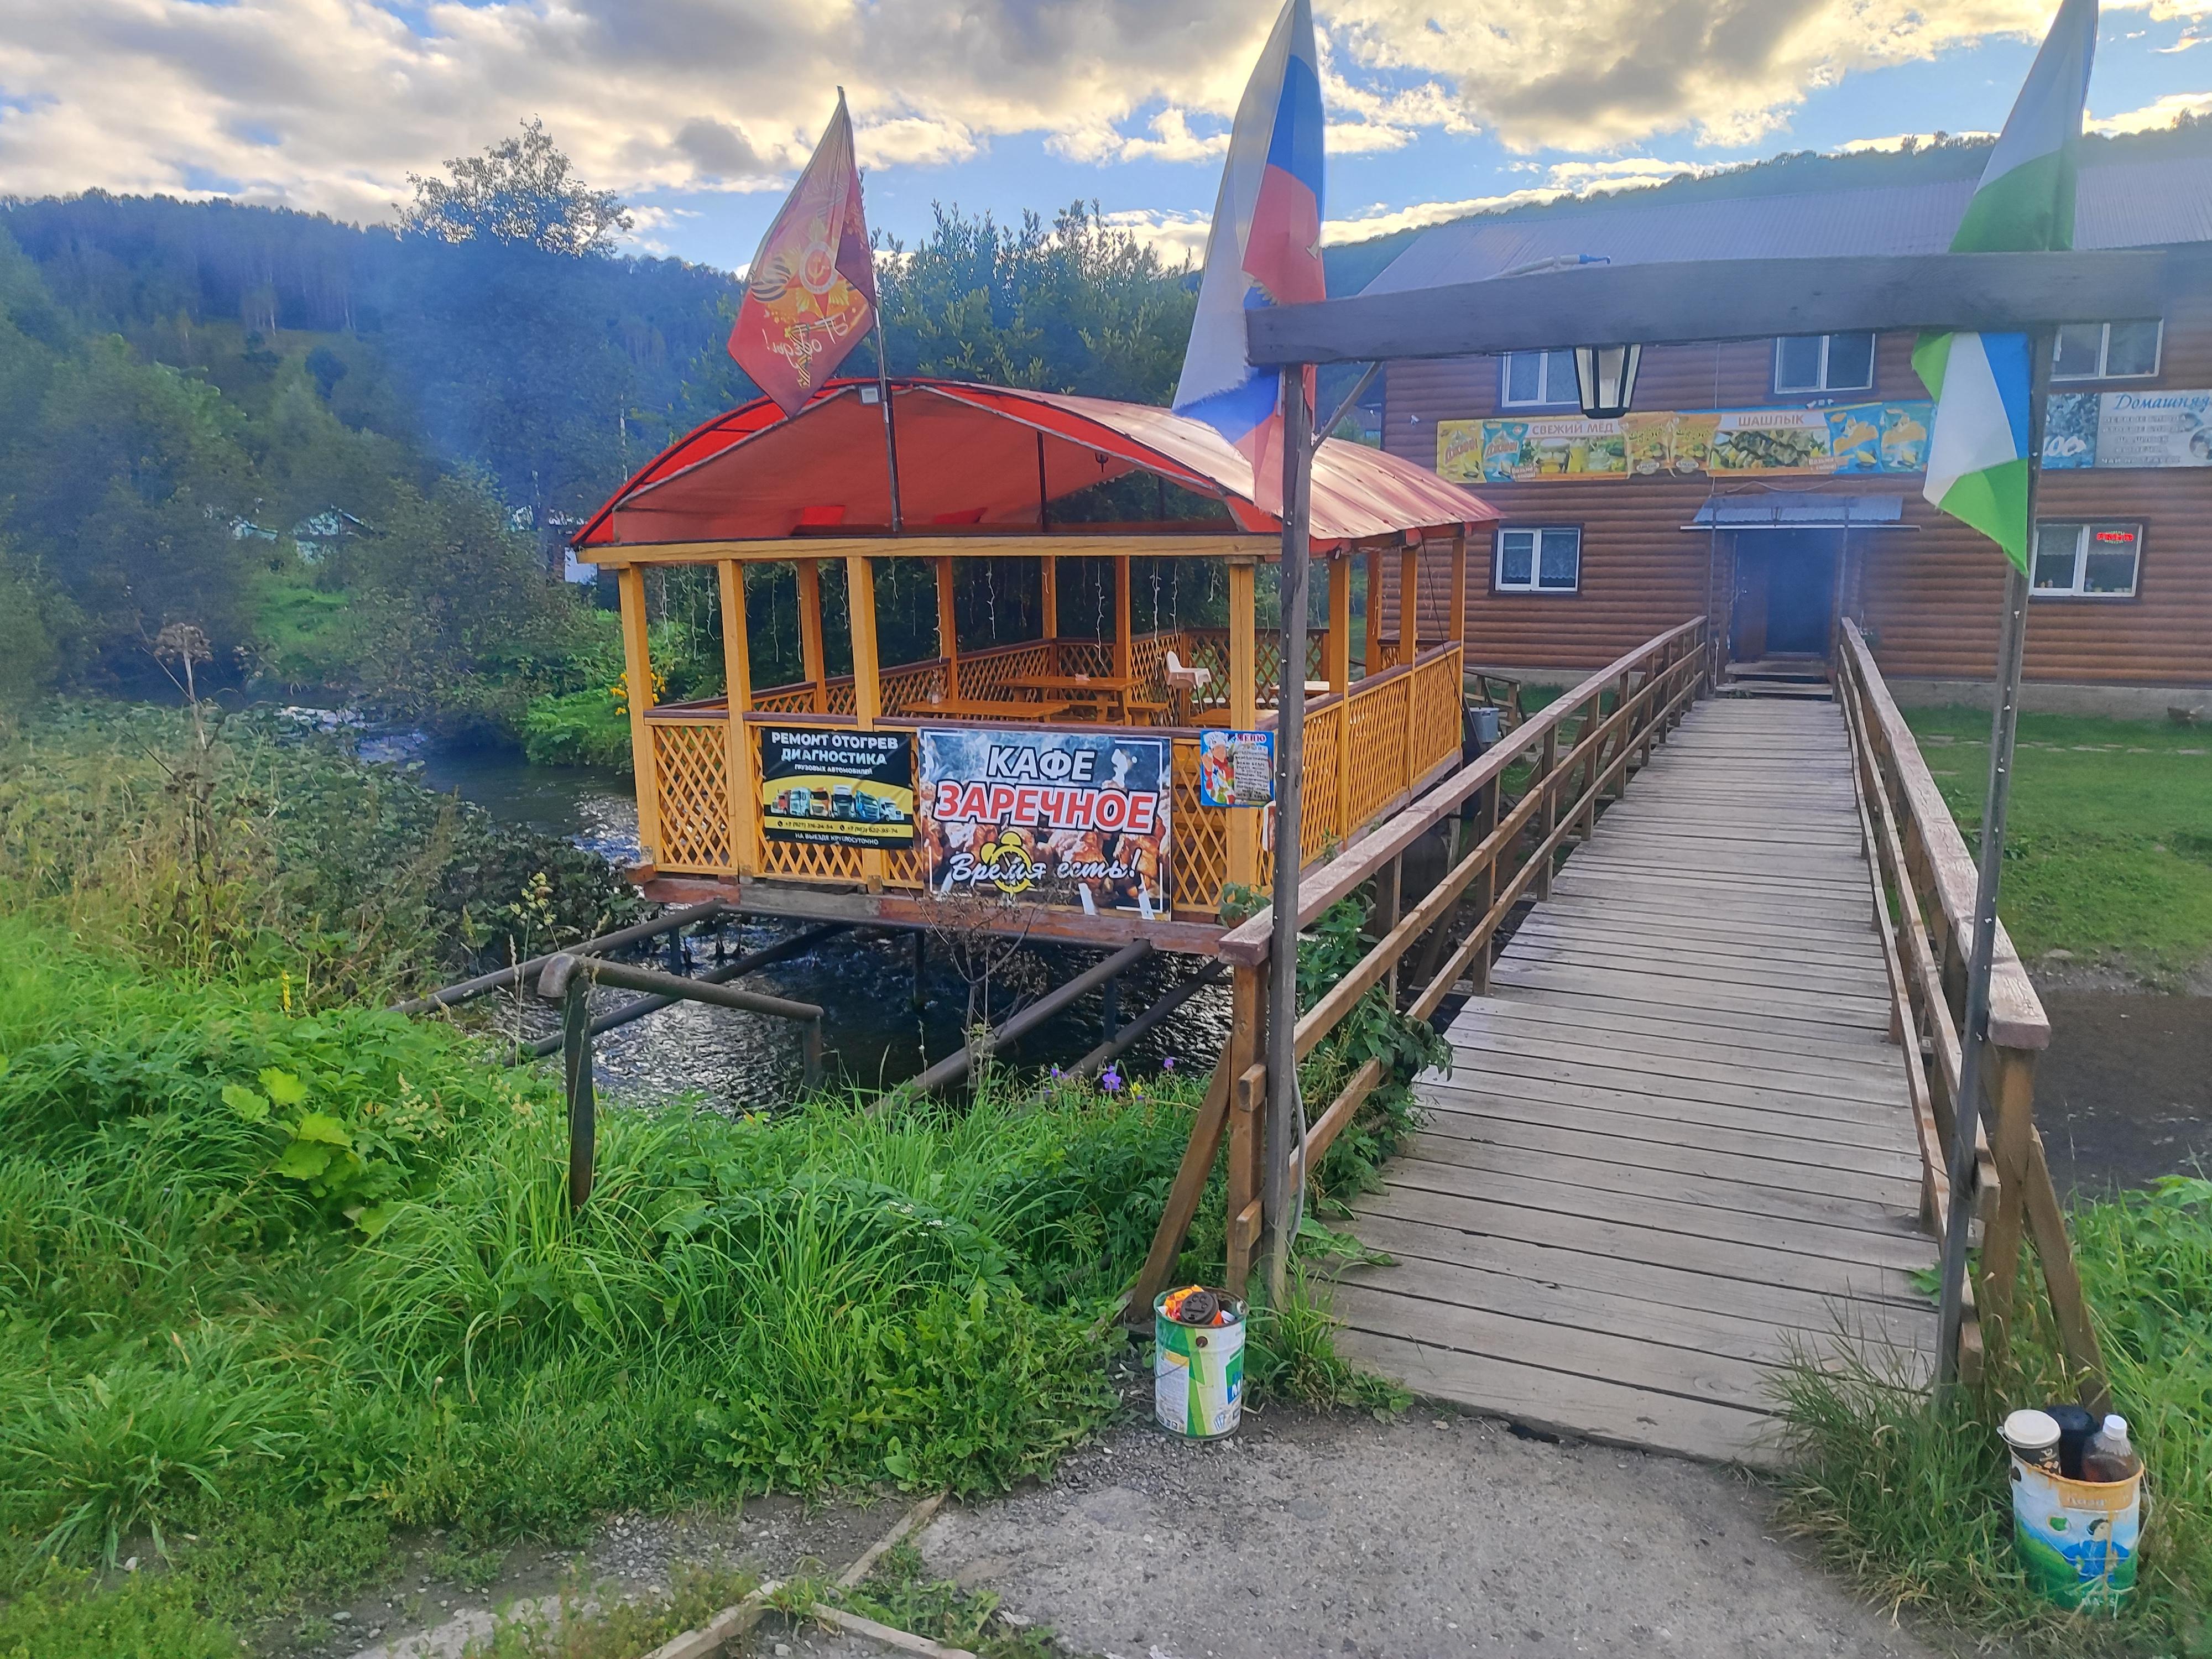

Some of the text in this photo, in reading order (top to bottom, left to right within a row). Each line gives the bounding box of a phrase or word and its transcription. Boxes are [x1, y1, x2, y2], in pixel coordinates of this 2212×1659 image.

[1532, 420, 1614, 435] СВЕЖИЙ МЁД
[1738, 414, 1805, 427] ШАШЛЫК
[771, 731, 899, 749] РЕМОНТ ОТОГРЕВ
[781, 748, 888, 765] ДИАГНОСТИКА
[987, 745, 1097, 781] КАФЕ
[795, 764, 873, 775] ГРУЗОВЫХ АВТОМОБИЛЕЙ
[934, 781, 1157, 833] ЗАРЕЧНОЕ
[831, 835, 879, 846] КРУГЛОСУТОЧНО
[1056, 848, 1141, 879] есть!
